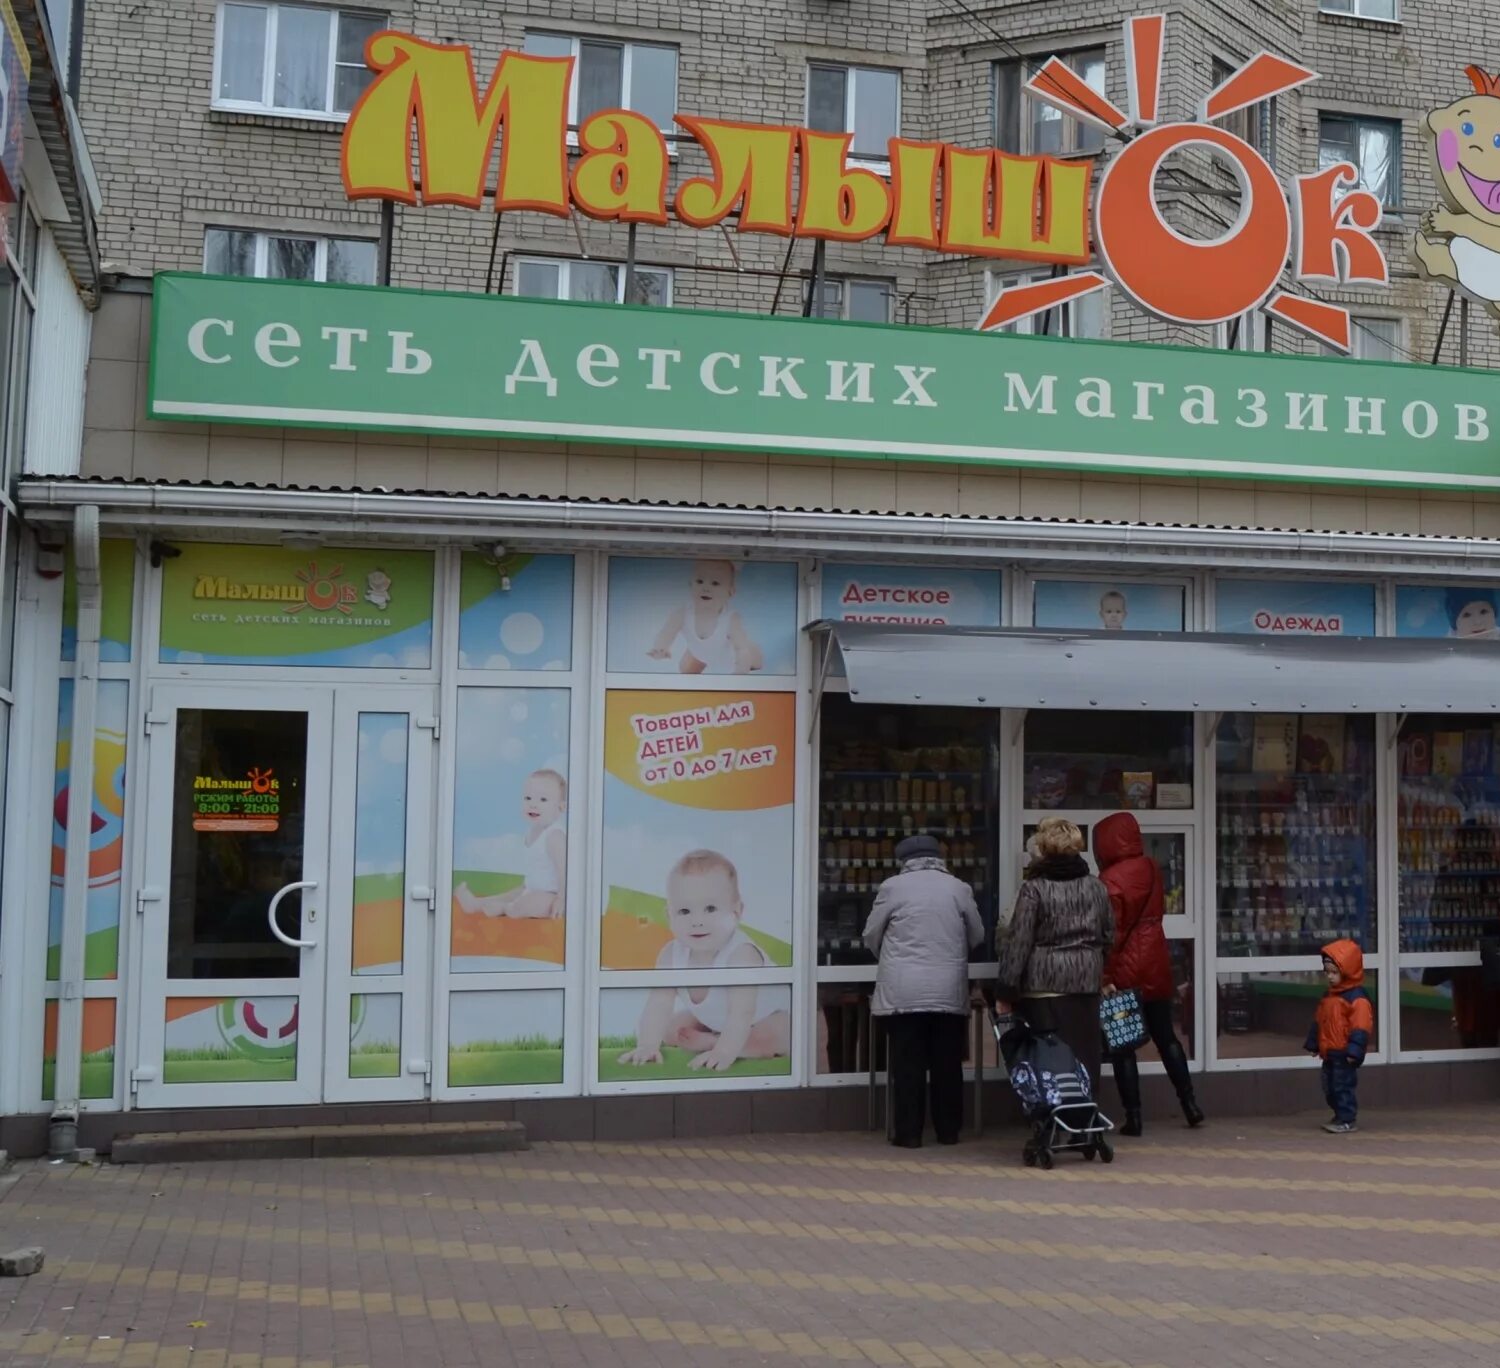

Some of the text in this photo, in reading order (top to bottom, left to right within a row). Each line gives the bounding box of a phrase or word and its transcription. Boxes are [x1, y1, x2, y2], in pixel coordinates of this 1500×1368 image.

[187, 317, 1490, 443] сеть детских магазинов
[842, 583, 950, 604] Детское
[192, 613, 391, 626] сеть детских магазинов
[1255, 612, 1339, 632] Одежда
[635, 705, 750, 733] Товары для
[640, 731, 699, 760] ДЕТЕЙ
[645, 749, 773, 782] от 0 до 7 лет
[244, 803, 279, 813] 21:00
